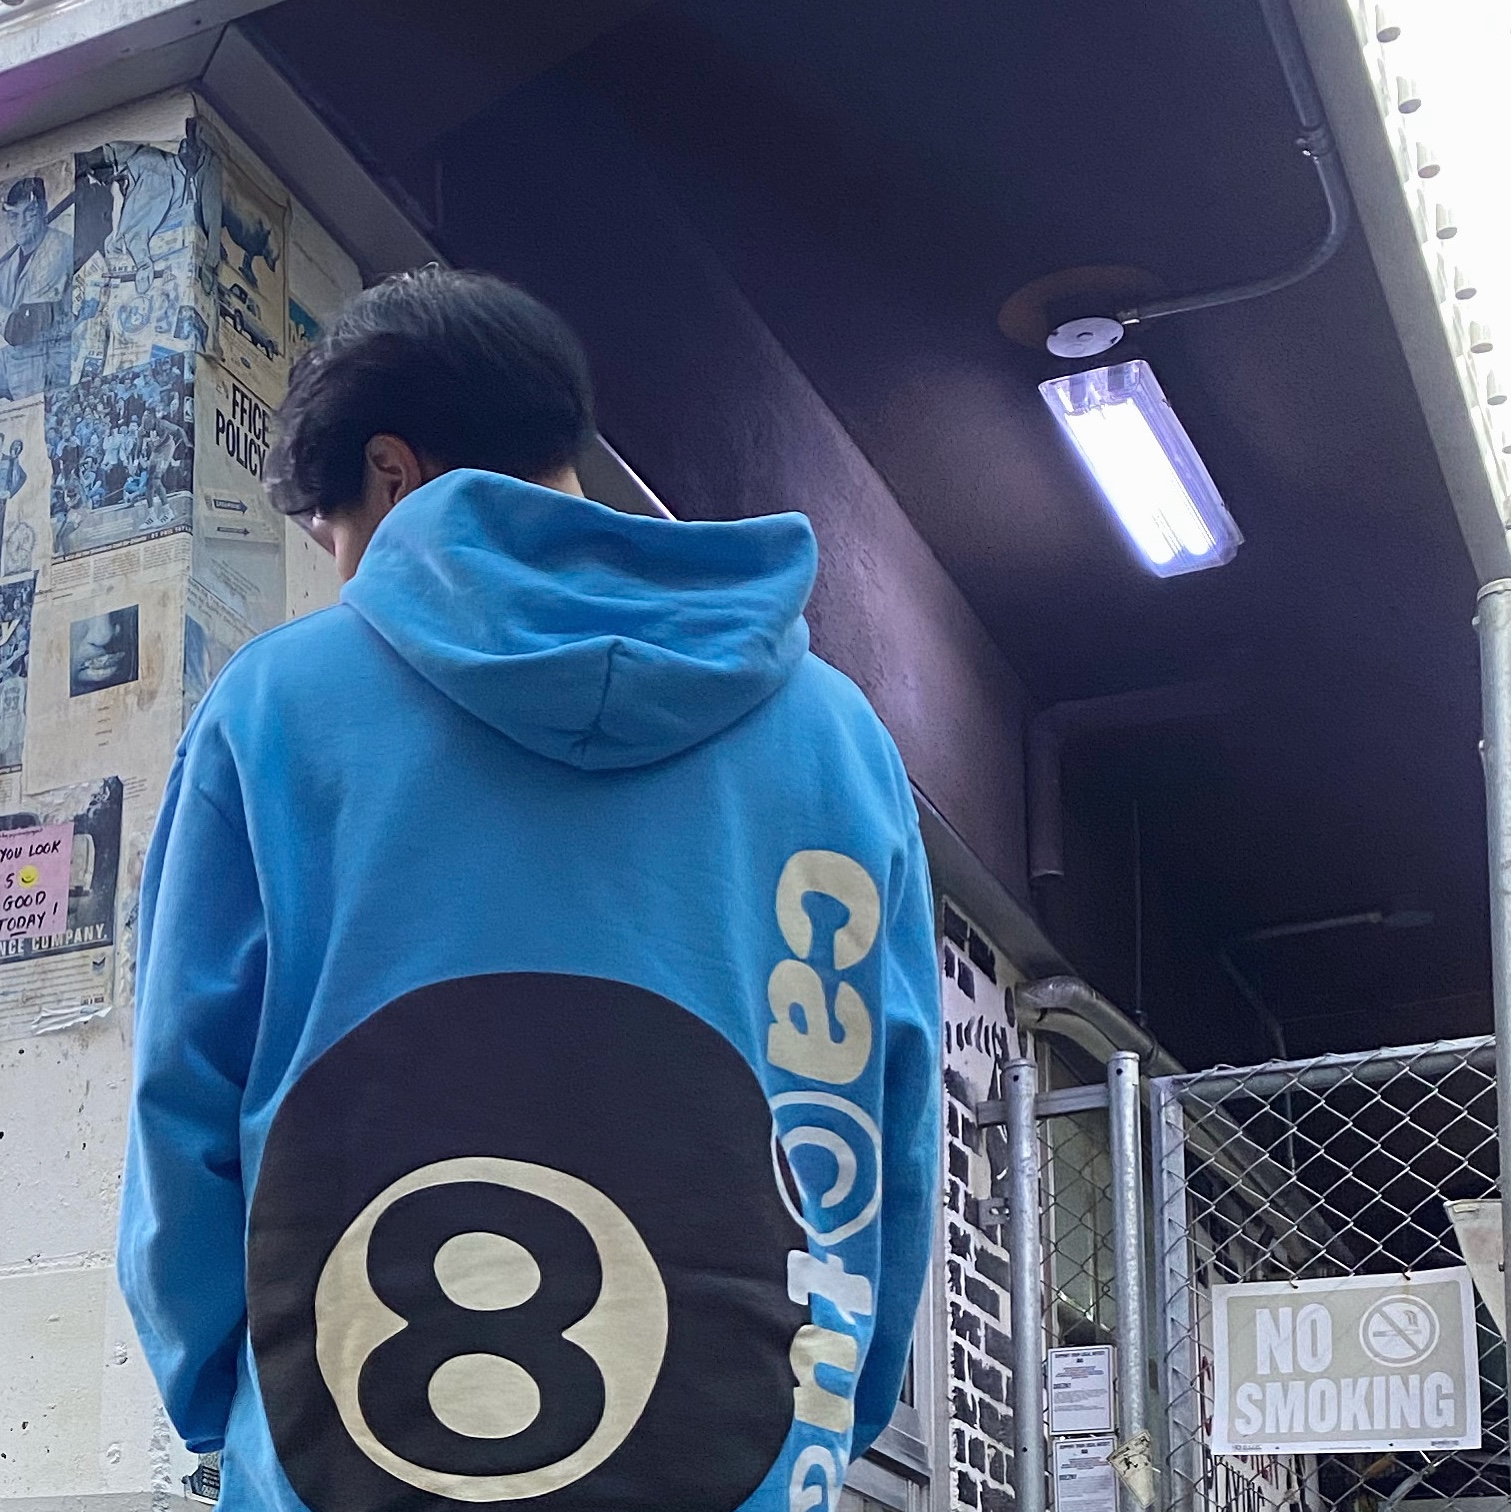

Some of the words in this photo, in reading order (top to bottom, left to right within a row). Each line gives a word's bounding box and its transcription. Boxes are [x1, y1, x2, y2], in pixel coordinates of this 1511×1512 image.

[232, 383, 271, 449] FFICE
[0, 847, 23, 863] YOU
[28, 840, 61, 857] LOOK
[3, 891, 46, 911] GOOD
[357, 1180, 607, 1477] 8
[1255, 1303, 1333, 1375] NO
[1234, 1371, 1455, 1436] SMOKING
